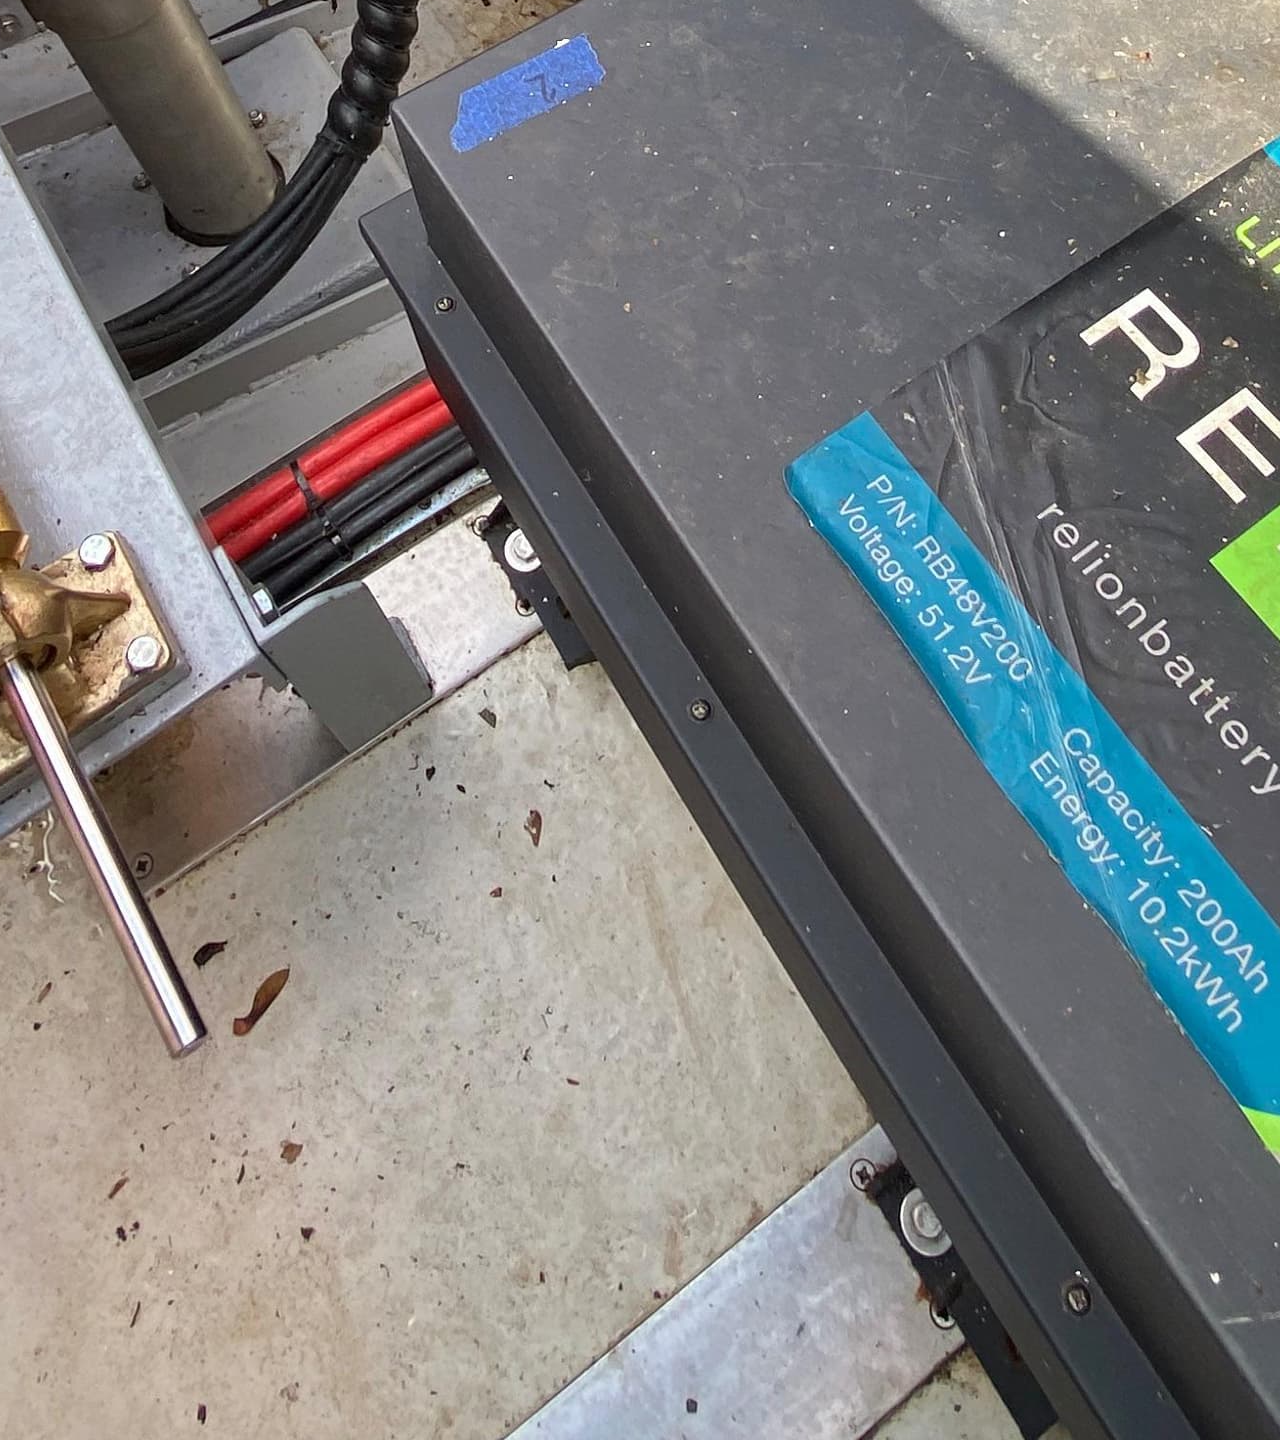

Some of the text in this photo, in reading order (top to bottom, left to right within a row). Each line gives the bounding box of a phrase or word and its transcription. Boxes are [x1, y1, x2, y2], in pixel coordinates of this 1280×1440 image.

[839, 494, 992, 687] Voltage: 51.2V
[867, 474, 1034, 682] P/N: RB48V200
[1029, 751, 1243, 1033] Energy: 10.2kWh
[1063, 727, 1269, 994] Capacity: 200Ah
